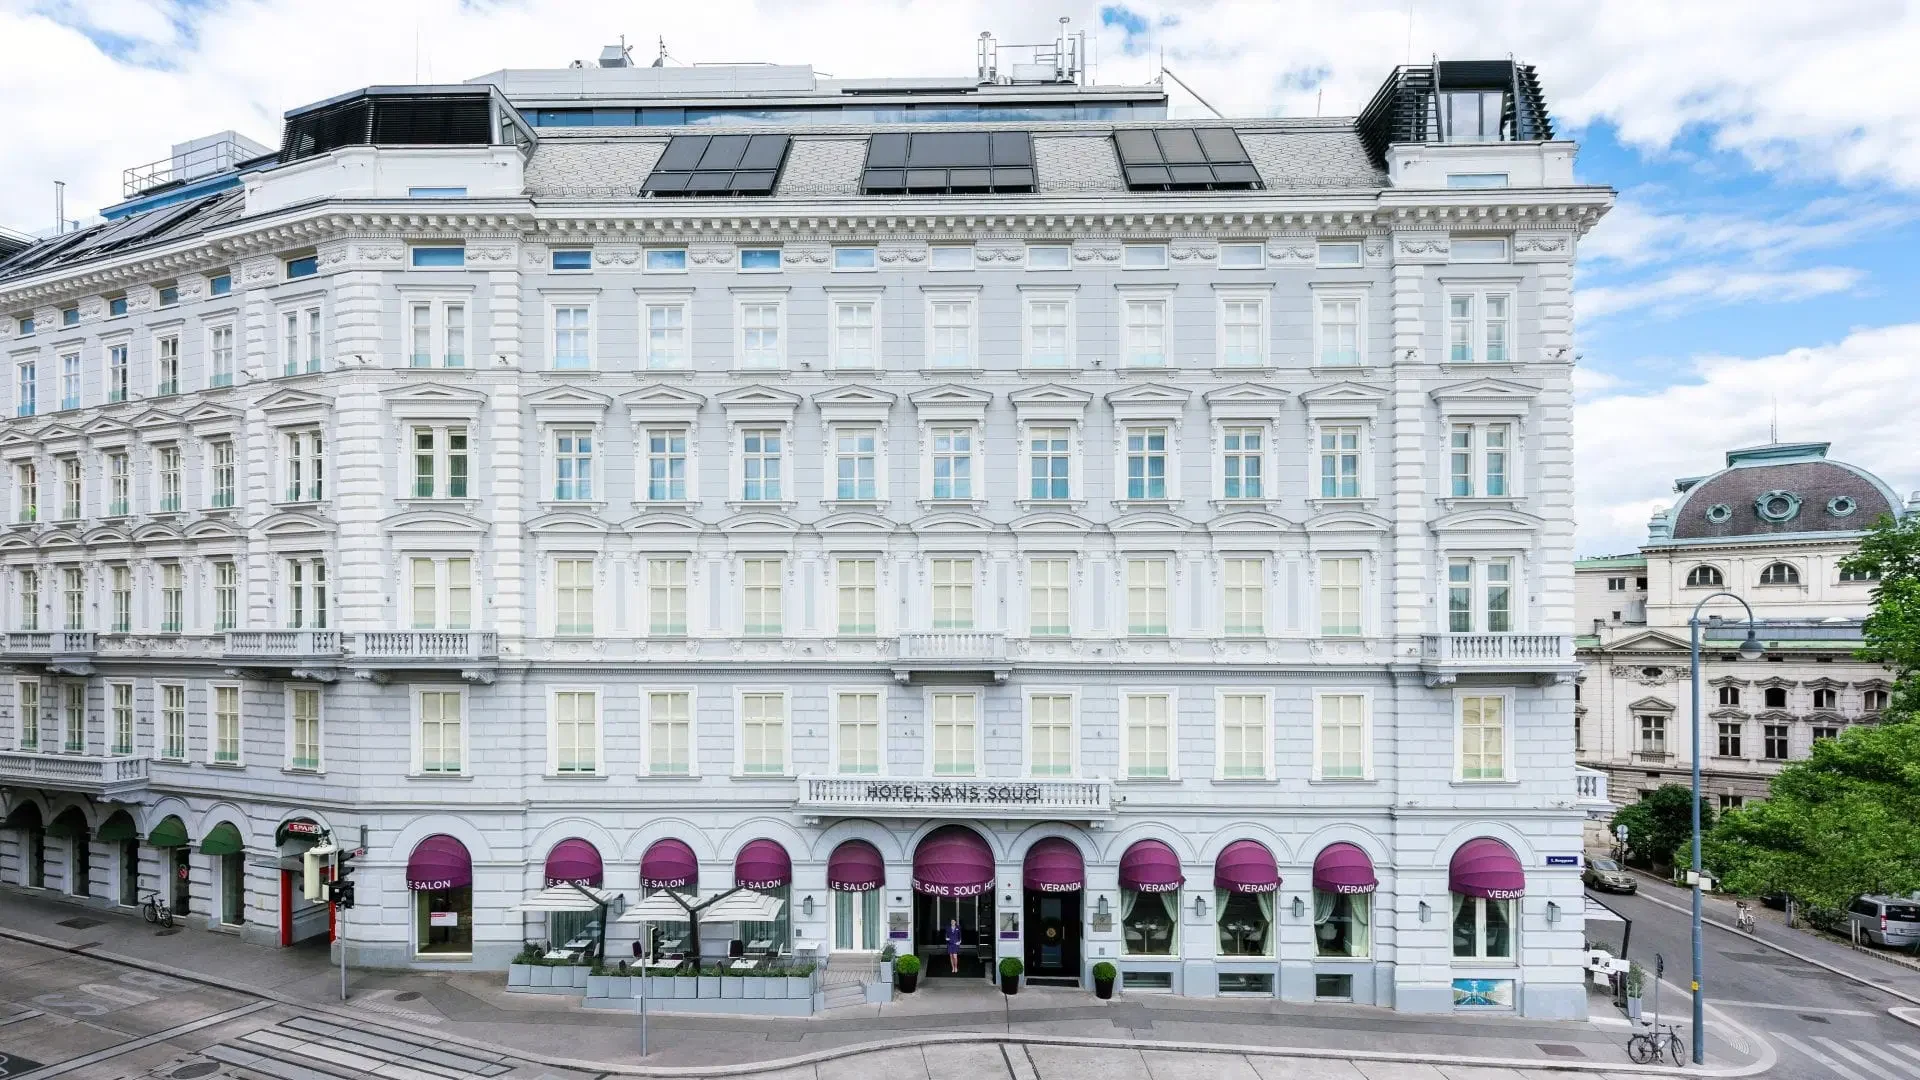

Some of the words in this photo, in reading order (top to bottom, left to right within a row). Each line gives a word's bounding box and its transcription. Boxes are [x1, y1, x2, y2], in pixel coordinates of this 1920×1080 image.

[867, 784, 924, 799] HOTEL
[931, 784, 980, 800] SANS
[987, 785, 1041, 800] SOUCI
[414, 880, 451, 890] SALON
[556, 878, 590, 887] SAON
[641, 877, 649, 887] LE
[651, 878, 685, 888] SALON
[737, 879, 746, 888] LE
[748, 879, 781, 889] SALON
[831, 880, 841, 890] LE
[843, 881, 876, 891] SALON
[1040, 881, 1081, 892] VERANDA
[924, 883, 949, 896] SANS
[953, 884, 981, 896] SOUCI
[1487, 889, 1525, 899] VERAND
